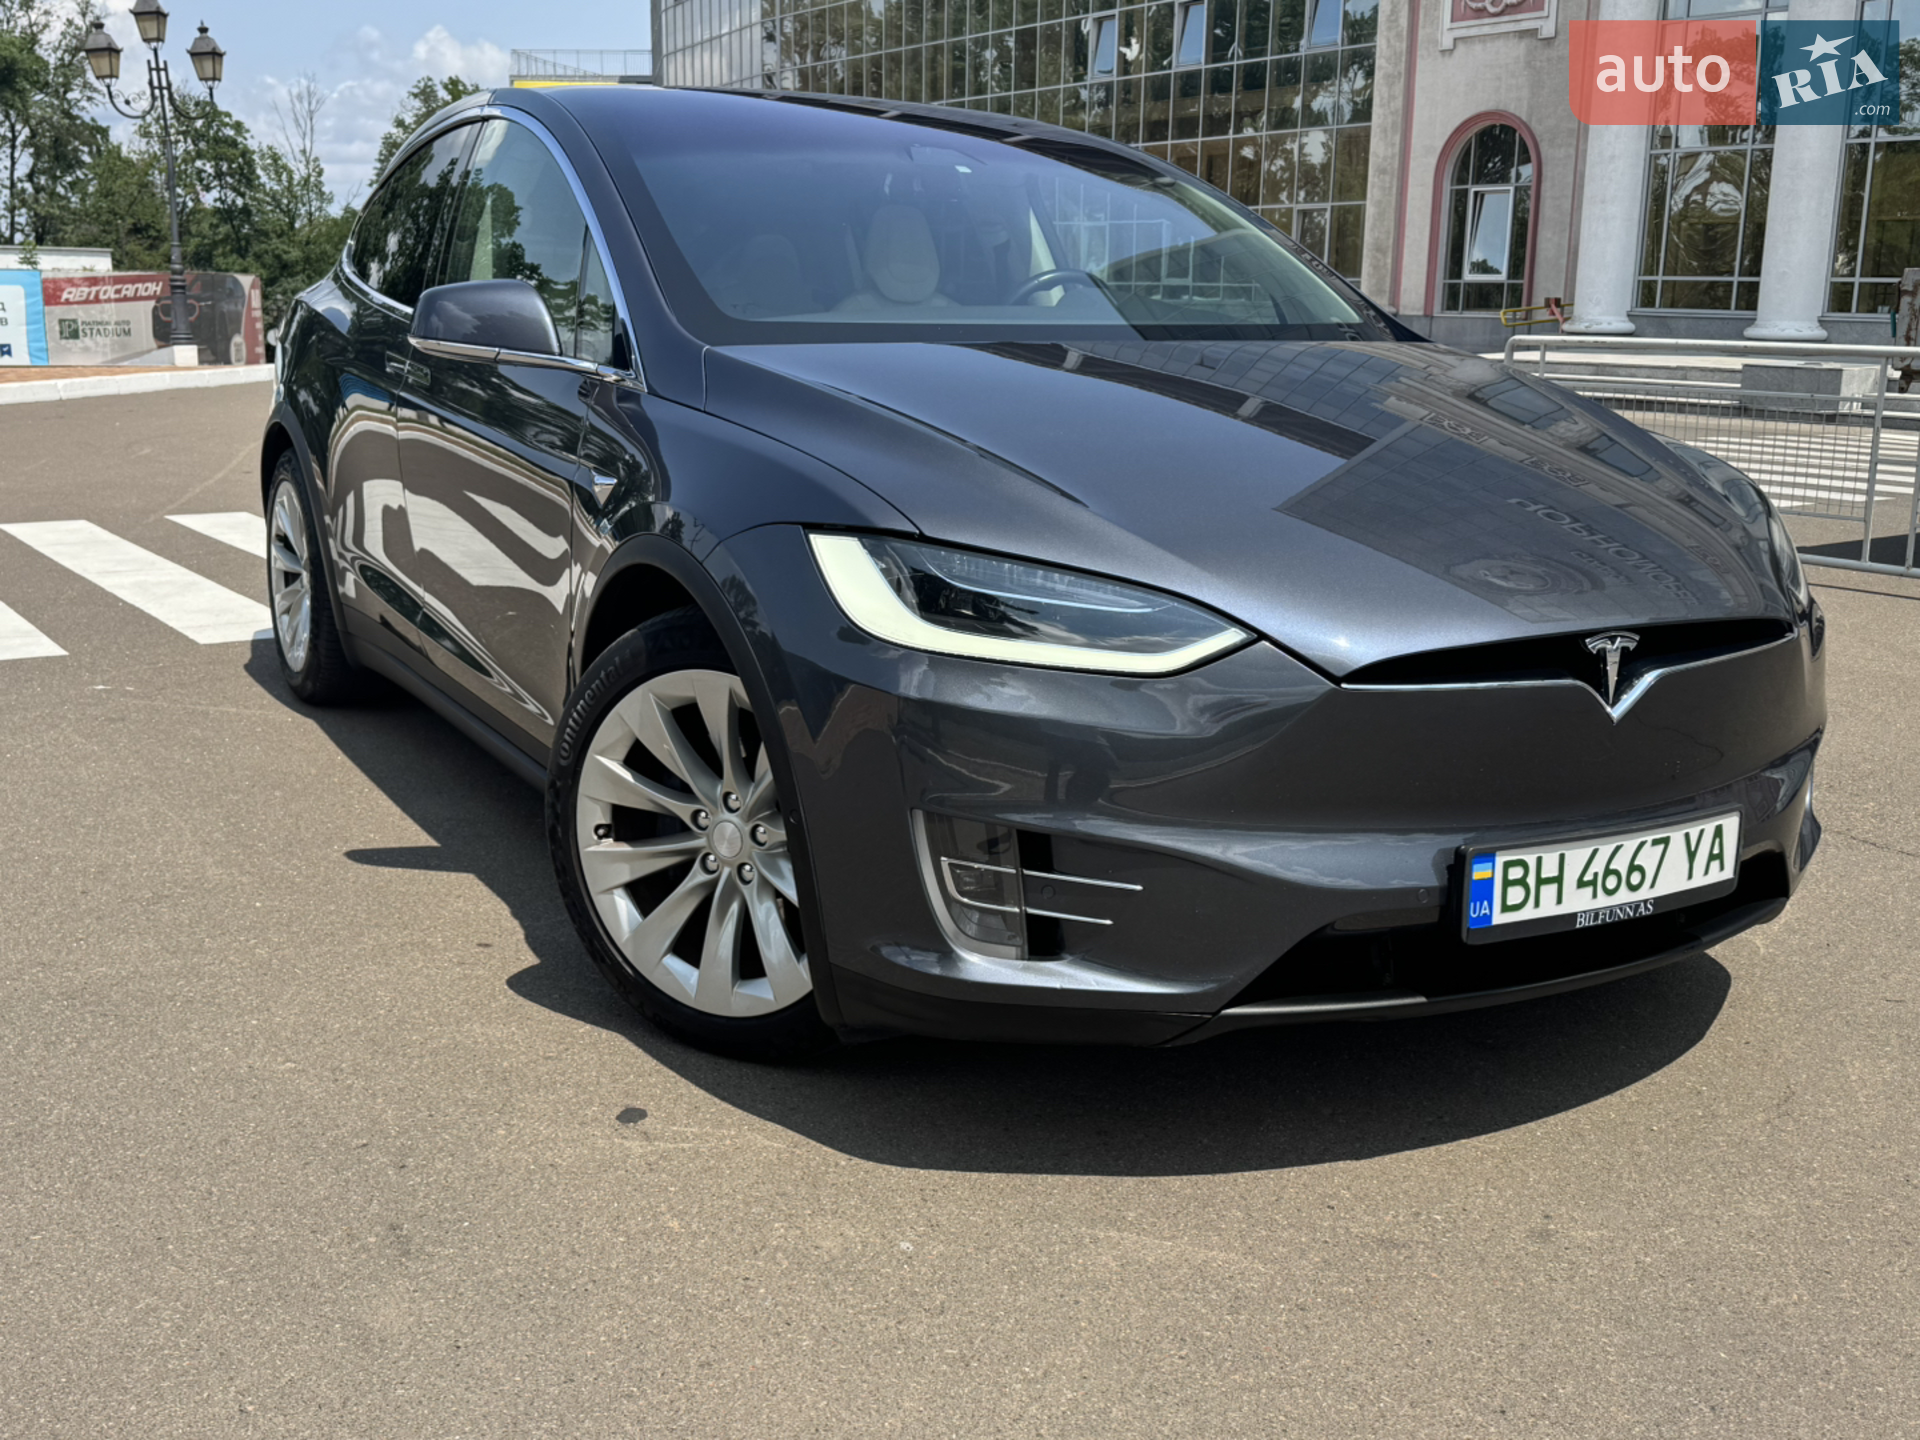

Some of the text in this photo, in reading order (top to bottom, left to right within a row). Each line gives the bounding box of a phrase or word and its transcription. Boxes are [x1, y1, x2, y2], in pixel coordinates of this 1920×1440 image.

[60, 281, 163, 302] АВТОСАЛОН
[81, 327, 132, 338] STADIUM
[1500, 823, 1725, 914] BH 4667 YA
[1470, 900, 1491, 918] UA
